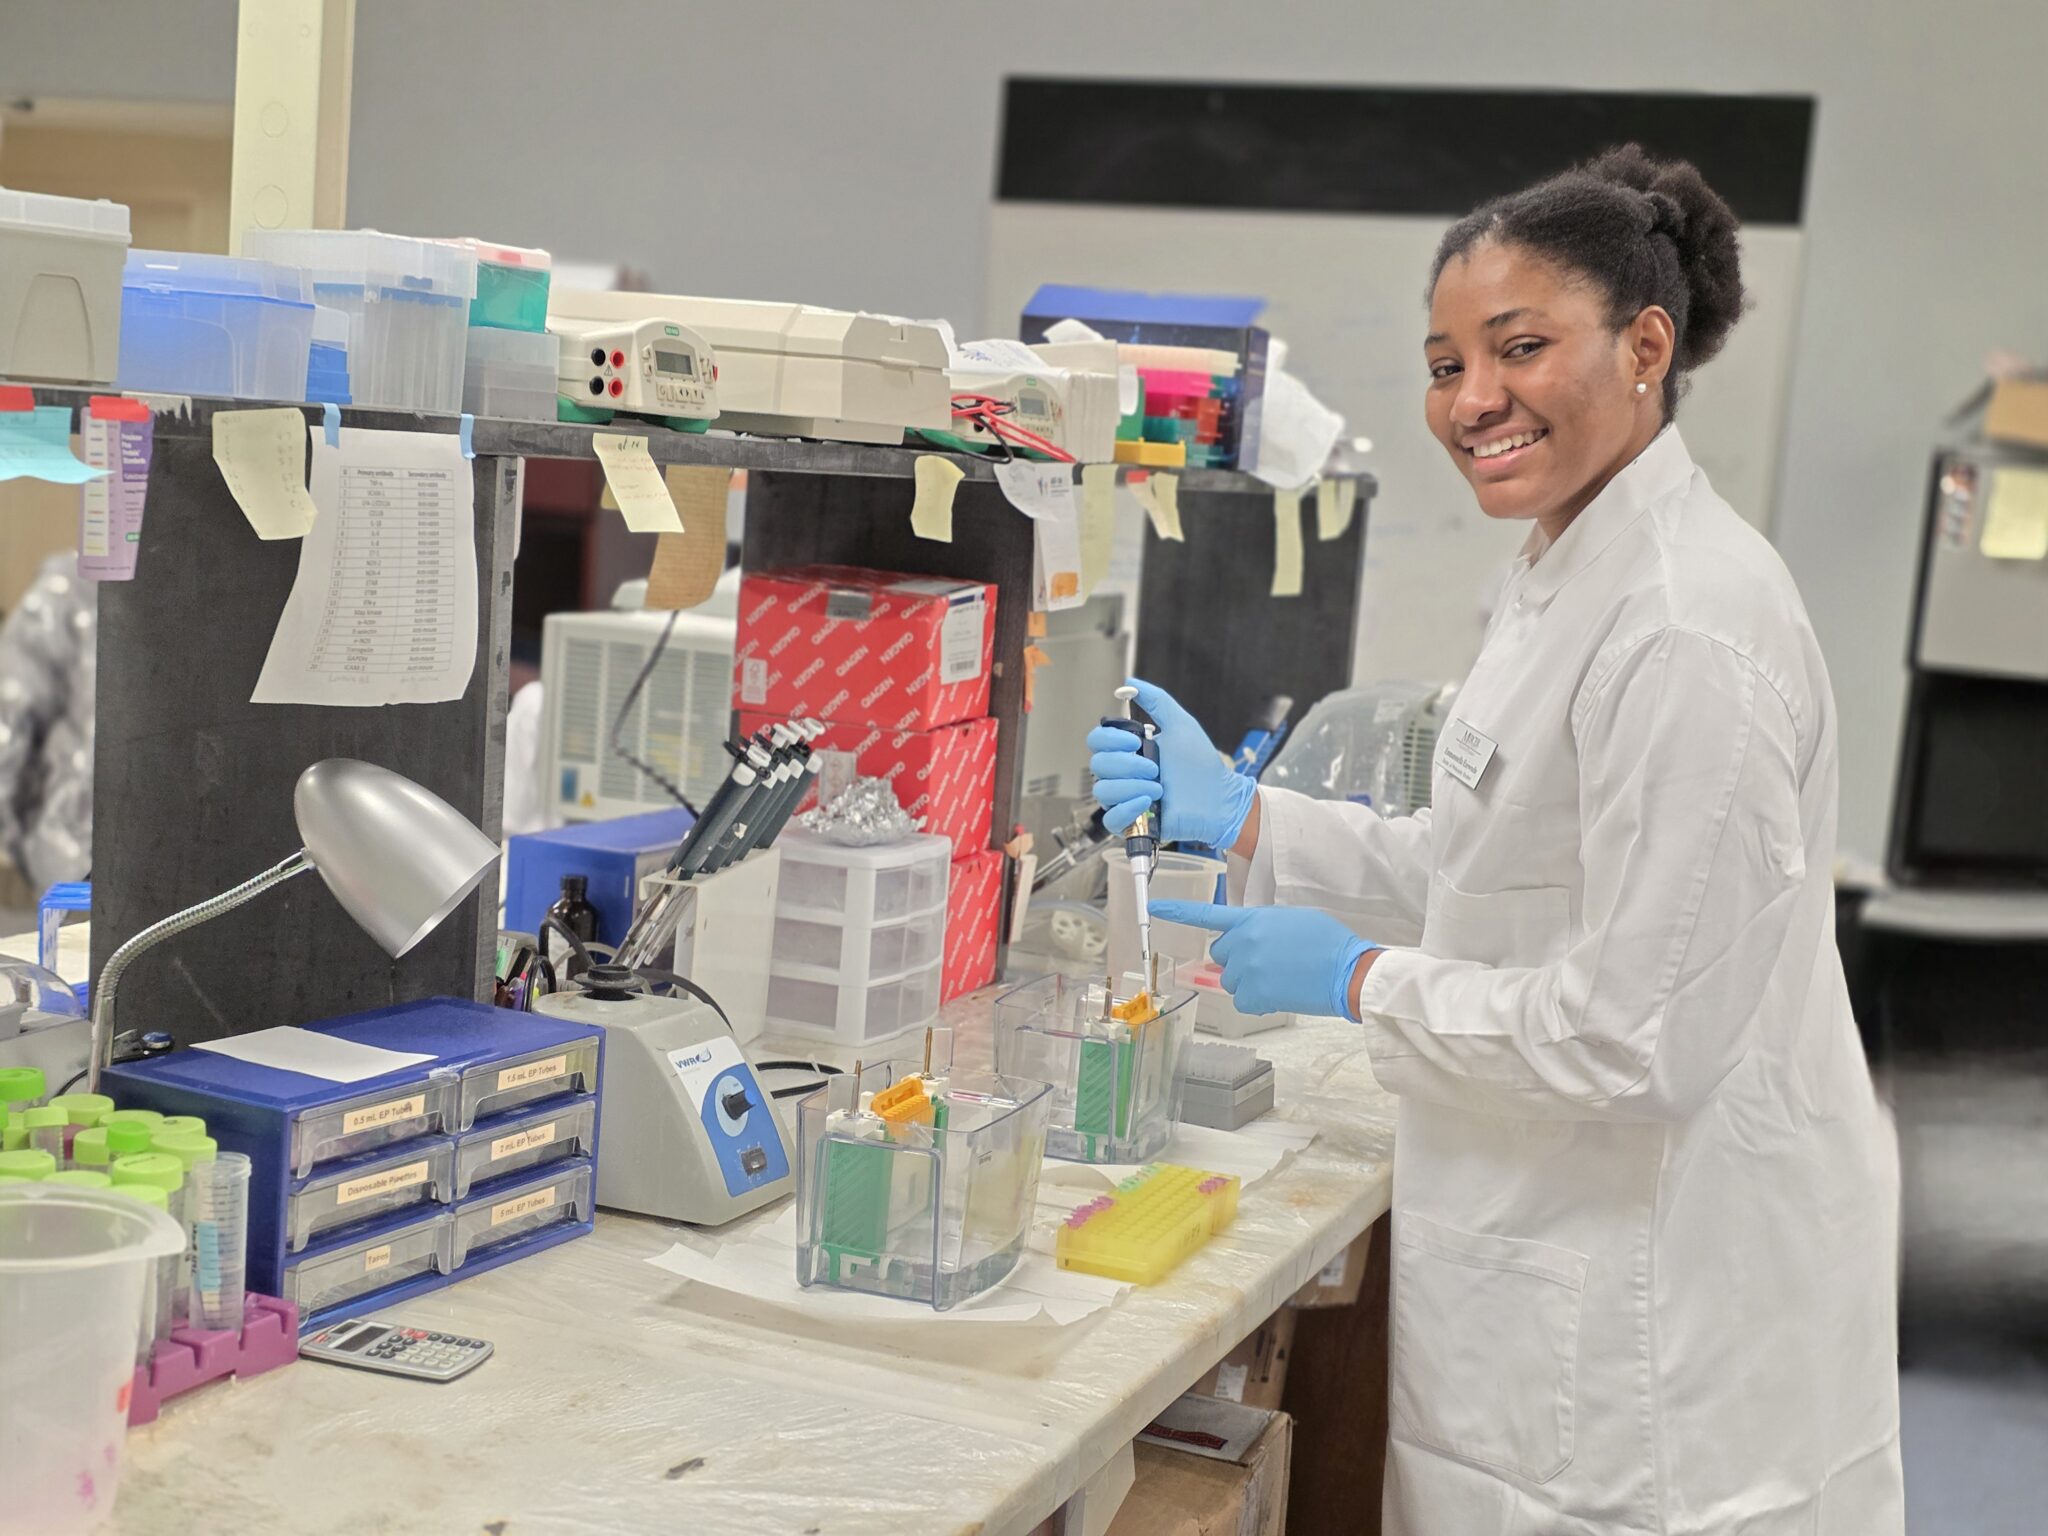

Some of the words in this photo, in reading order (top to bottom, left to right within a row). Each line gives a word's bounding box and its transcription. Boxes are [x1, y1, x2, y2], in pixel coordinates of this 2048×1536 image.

[746, 593, 778, 626] QIAGEN
[769, 625, 802, 658] QIAGEN
[879, 631, 915, 665] QIAGEN
[792, 657, 825, 690] QIAGEN
[836, 644, 869, 678] QIAGEN
[819, 688, 850, 720] QIAGEN
[860, 675, 896, 709] QIAGEN
[517, 1071, 527, 1080] mL
[528, 1068, 538, 1078] EP
[539, 1065, 557, 1075] Tubes
[675, 1057, 698, 1069] VWR
[366, 1113, 377, 1122] mL
[379, 1109, 390, 1120] EP
[505, 1142, 515, 1151] mL
[516, 1137, 526, 1148] EP
[527, 1133, 545, 1144] Tubes
[348, 1179, 387, 1196] Disposable
[500, 1209, 505, 1218] 5
[505, 1205, 515, 1216] mL
[516, 1201, 526, 1212] EP
[527, 1197, 546, 1208] Tubes
